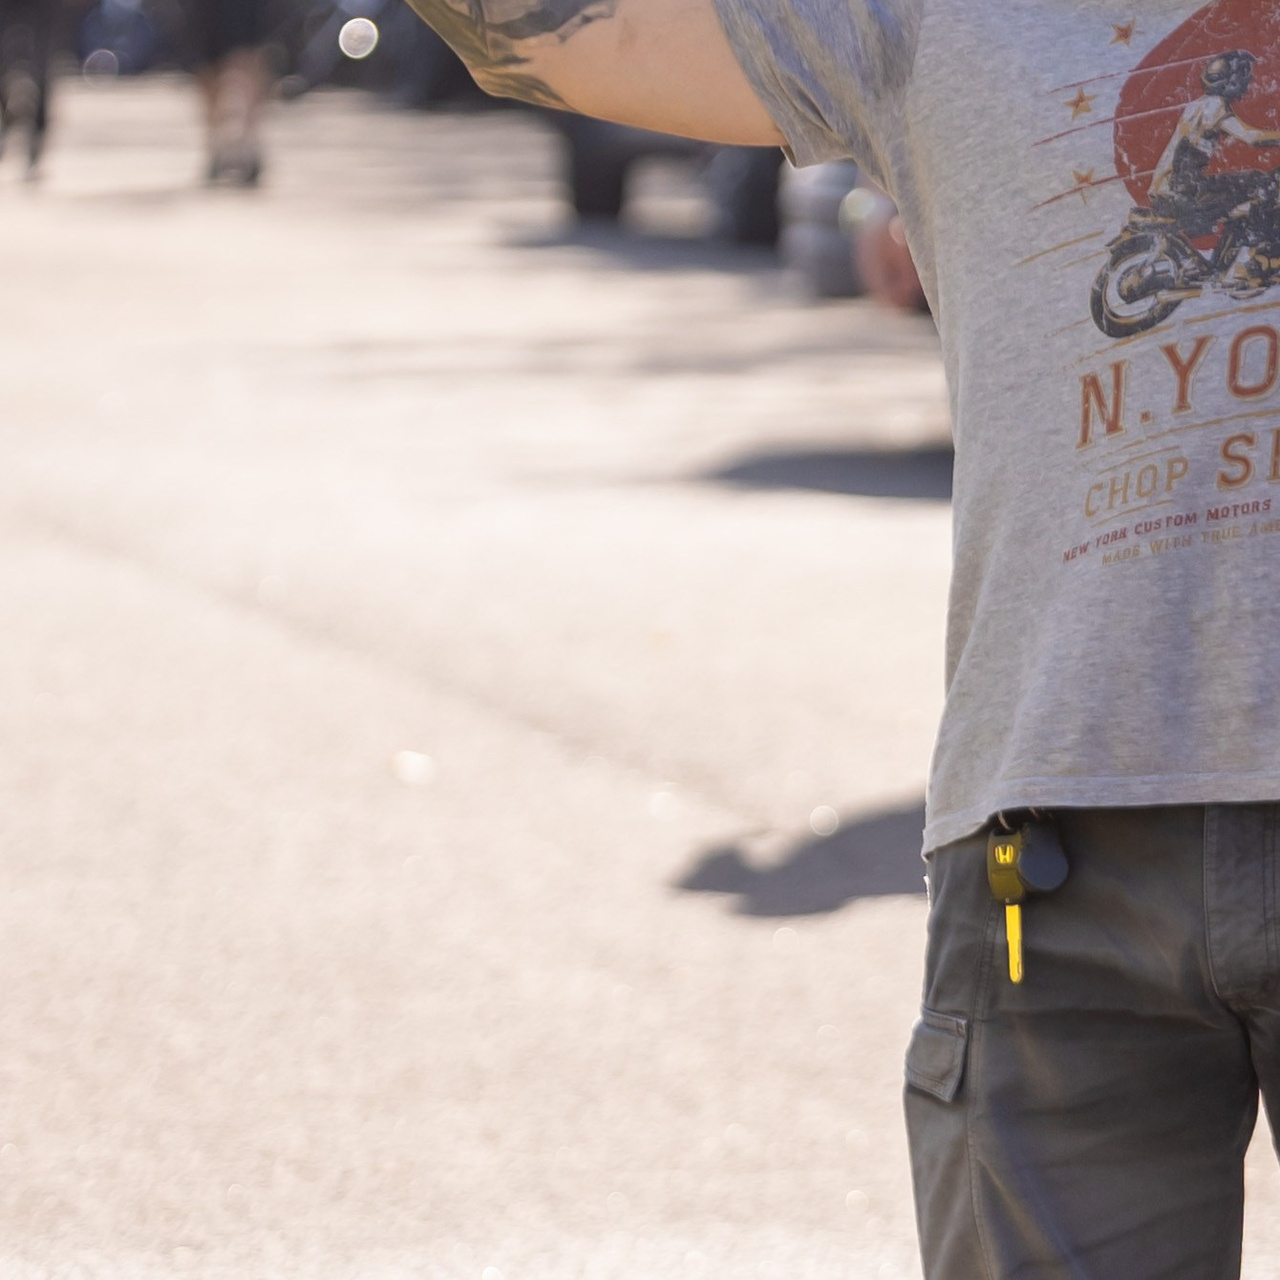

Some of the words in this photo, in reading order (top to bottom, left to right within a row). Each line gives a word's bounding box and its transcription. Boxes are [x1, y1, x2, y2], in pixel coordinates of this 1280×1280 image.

[1084, 455, 1189, 517] CHOP
[1062, 540, 1090, 563] NEW
[1094, 527, 1128, 546] YORK
[1134, 511, 1198, 536] CUSTOM
[1206, 498, 1272, 521] MOTORS
